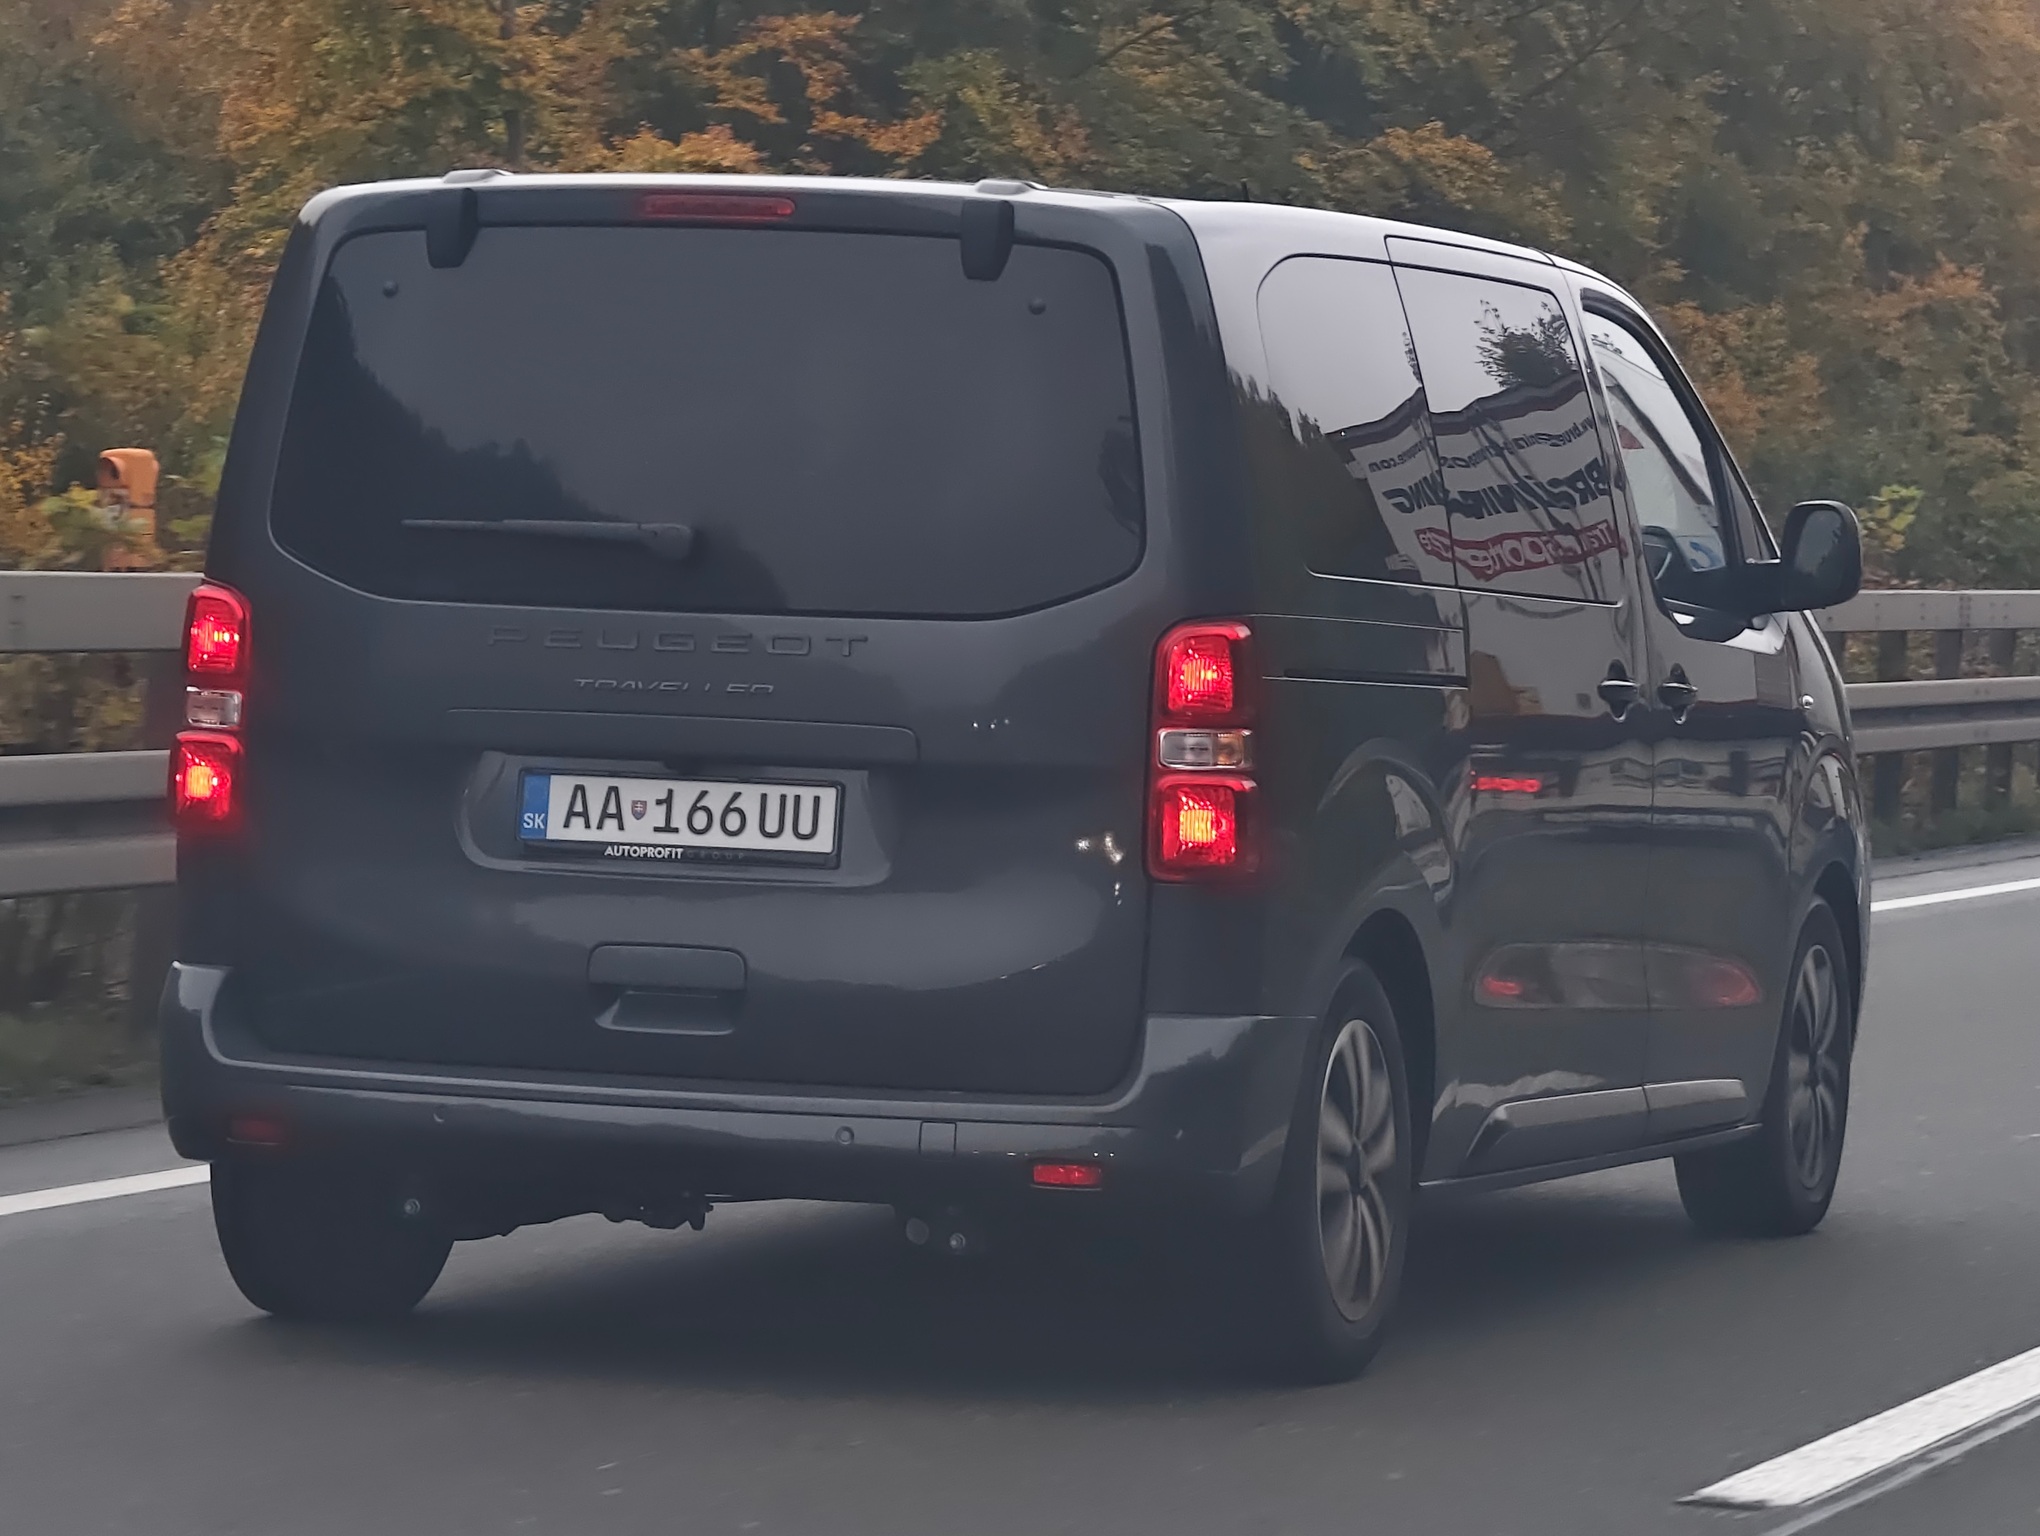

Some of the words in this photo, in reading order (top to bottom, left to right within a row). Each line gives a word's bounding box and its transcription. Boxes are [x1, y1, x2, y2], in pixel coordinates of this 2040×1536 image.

[486, 625, 869, 657] PEUGEOT
[523, 812, 546, 829] SK
[604, 845, 685, 859] AUTOPROFIT
